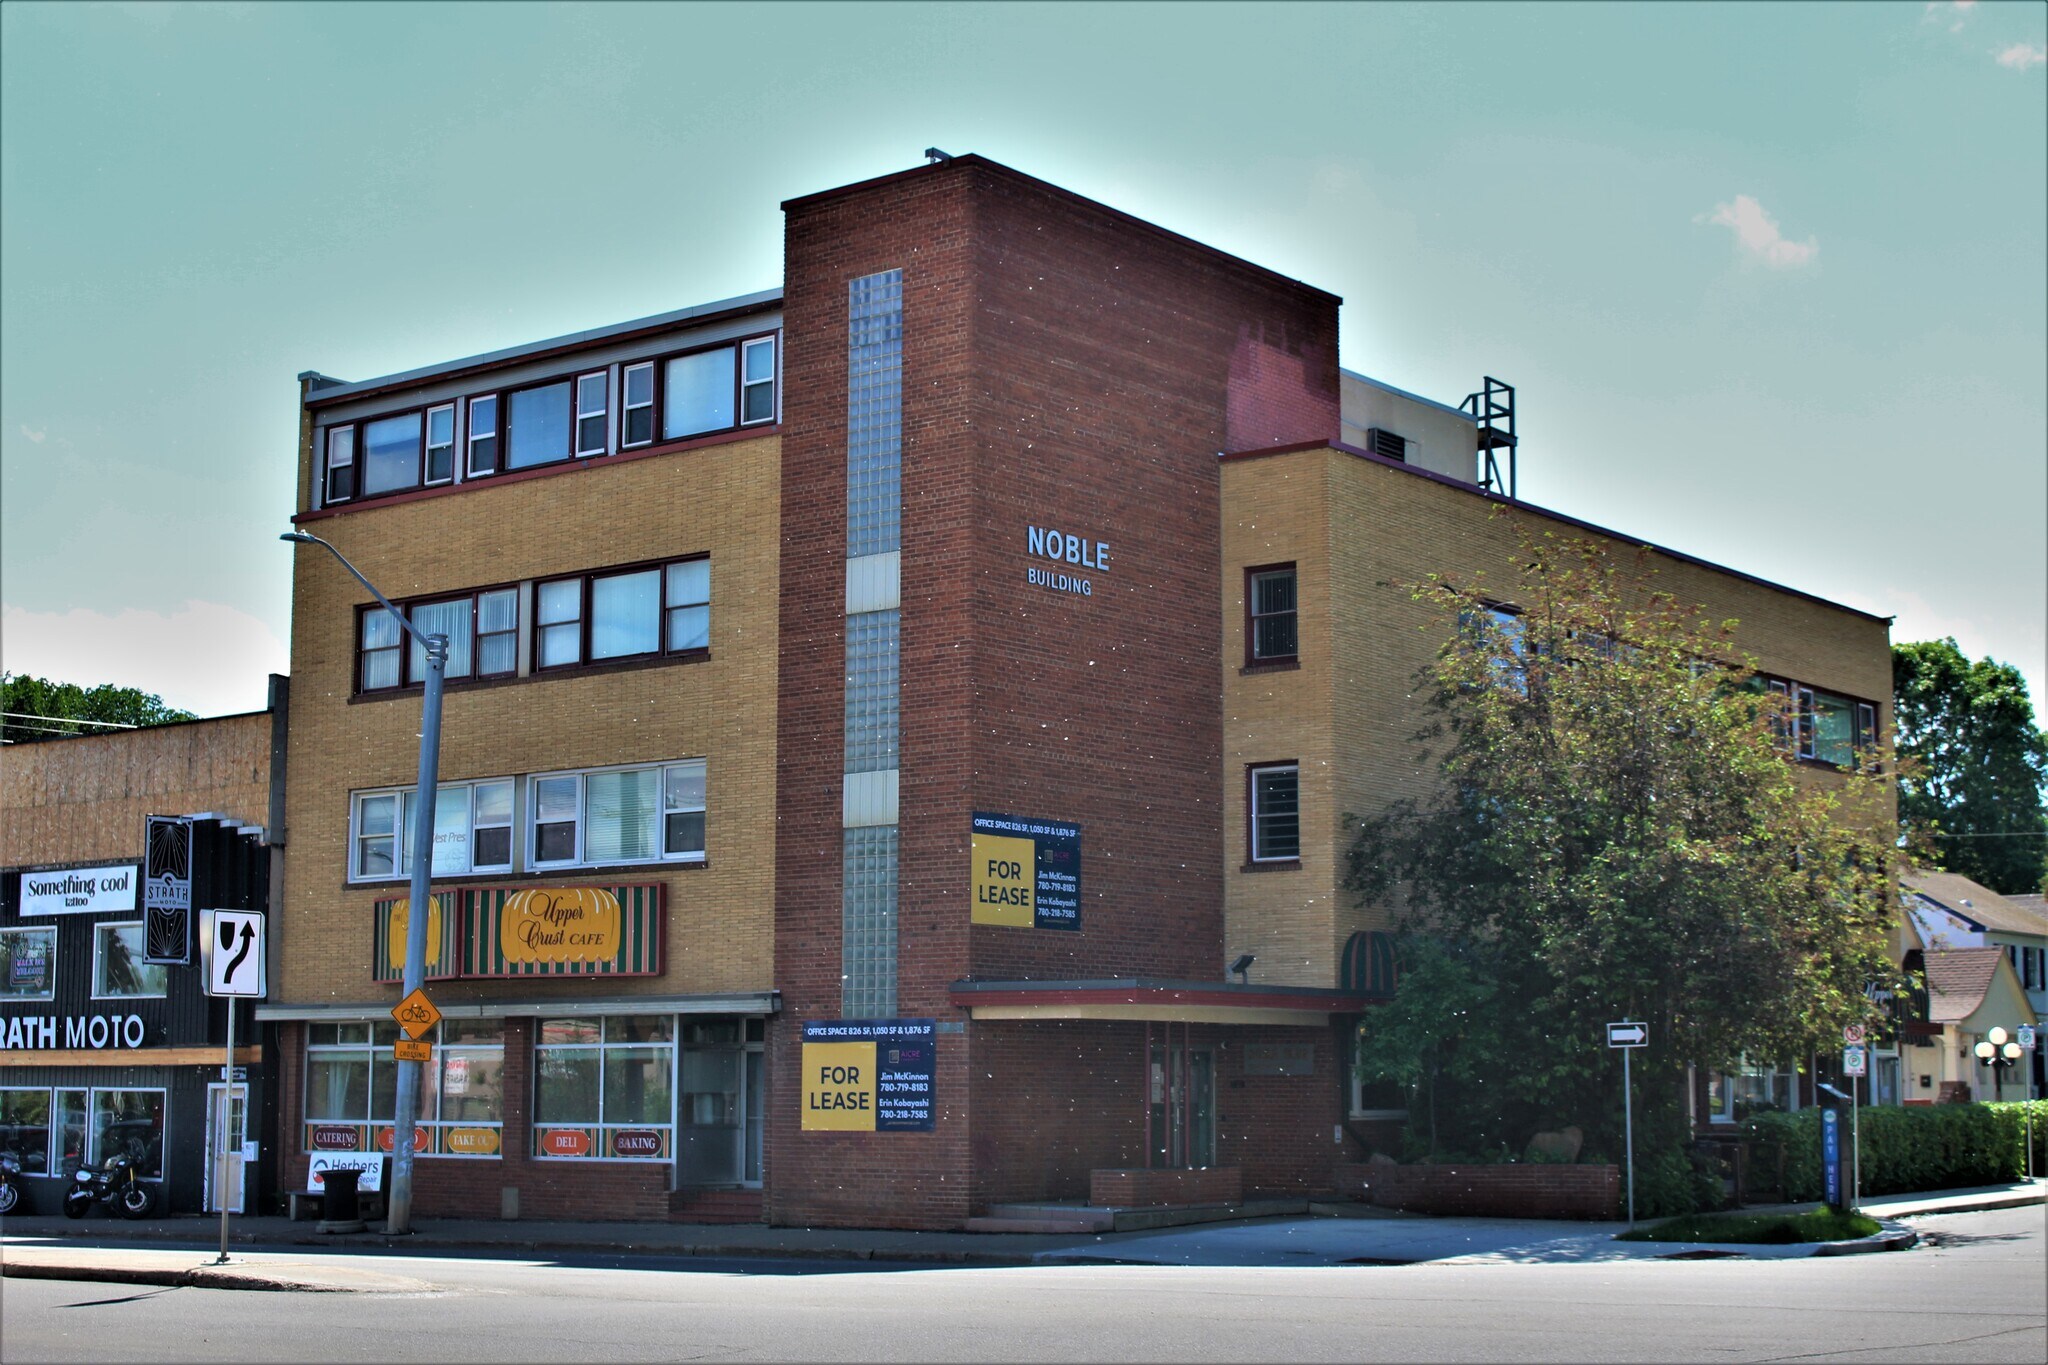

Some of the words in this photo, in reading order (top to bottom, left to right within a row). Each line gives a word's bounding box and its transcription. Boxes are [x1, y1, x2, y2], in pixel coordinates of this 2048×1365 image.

[1028, 525, 1110, 571] NOBLE
[1028, 568, 1091, 596] BUILDING
[974, 818, 994, 828] OFFICE
[995, 820, 1011, 830] SPACE
[1011, 822, 1021, 831] 826
[1044, 826, 1050, 834] SF
[1050, 827, 1056, 835] &
[1070, 829, 1076, 837] SF
[988, 860, 1021, 880] FOR
[1038, 870, 1048, 879] Jim
[1049, 871, 1076, 882] McKinnon
[28, 875, 95, 897] Something
[101, 871, 128, 892] cool
[148, 886, 188, 901] STRATH
[979, 885, 1030, 906] LEASE
[65, 897, 88, 907] tattoo
[529, 892, 585, 927] Upper
[1037, 896, 1048, 905] Erin
[1049, 897, 1076, 908] Kobayashi
[517, 920, 565, 952] Crust
[569, 933, 605, 945] CAFE
[66, 1014, 144, 1049] MOTO
[808, 1027, 827, 1036] OFFICE
[828, 1027, 847, 1036] SPACE
[848, 1027, 861, 1035] 826
[863, 1027, 872, 1036] SF,
[873, 1026, 888, 1036] 1,050
[889, 1026, 897, 1035] SF
[898, 1027, 903, 1035] &
[904, 1026, 922, 1036] 1,876
[923, 1026, 931, 1034] SF
[821, 1067, 860, 1084] FOR
[881, 1072, 893, 1080] Jim
[894, 1072, 929, 1080] McKinnon
[880, 1083, 929, 1092] 780-719-8183
[810, 1092, 870, 1110] LEASE
[879, 1098, 892, 1107] Erin
[893, 1098, 929, 1109] Kobayashi
[880, 1110, 928, 1119] 780-218-7585
[316, 1132, 357, 1144] CATERING
[452, 1134, 475, 1146] TAKE
[478, 1135, 495, 1146] OUT
[556, 1136, 577, 1148] DELI
[618, 1137, 656, 1149] BAKING
[1826, 1125, 1834, 1154] PAY
[1827, 1165, 1835, 1204] HERE
